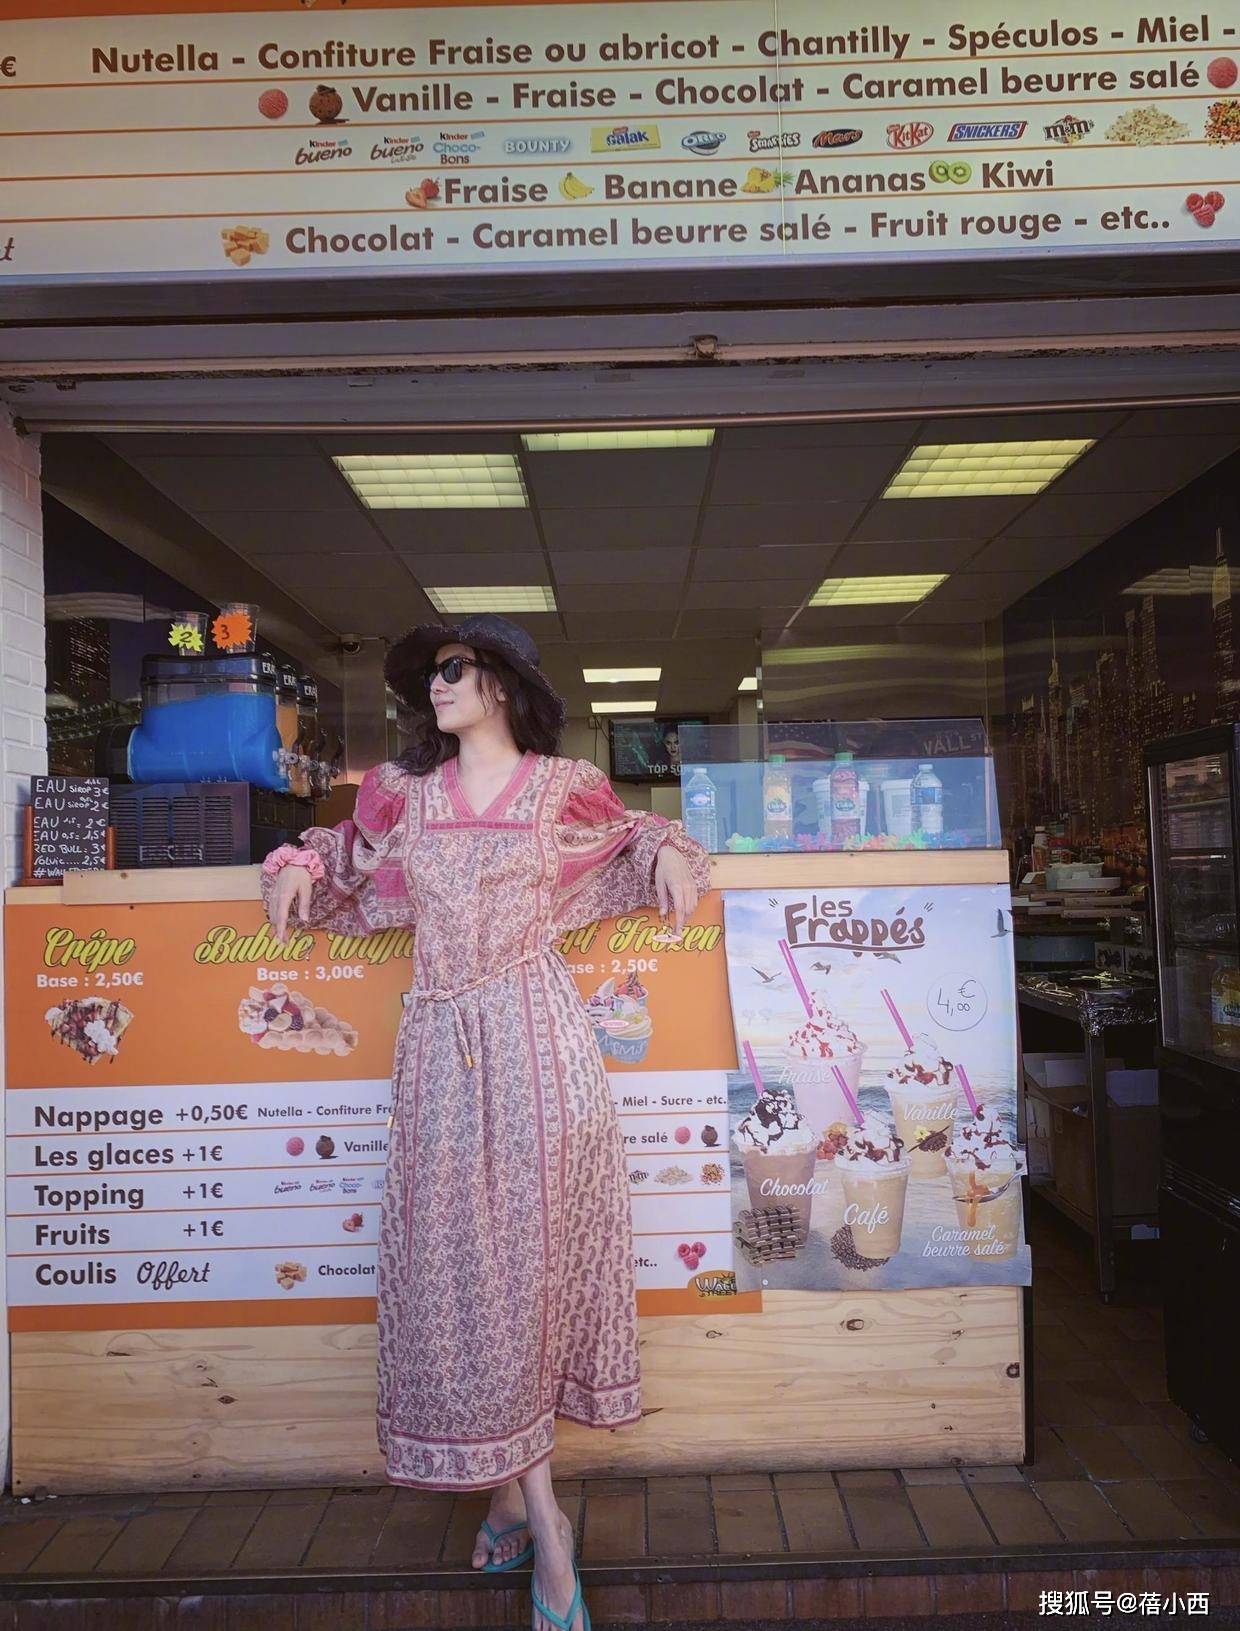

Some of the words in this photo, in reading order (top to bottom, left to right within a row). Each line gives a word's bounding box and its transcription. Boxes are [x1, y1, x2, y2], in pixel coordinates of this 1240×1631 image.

[93, 44, 218, 73] Nutella
[258, 41, 415, 69] Confiture
[430, 38, 532, 65] Fraise
[545, 43, 586, 62] ou
[599, 33, 719, 61] abricot
[758, 25, 910, 59] Chantilly
[948, 20, 1098, 56] Spéculos
[1137, 15, 1208, 43] Miel
[352, 83, 473, 112] Vanille
[513, 81, 616, 108] Fraise
[655, 76, 804, 105] Chocolat
[842, 67, 988, 99] Caramel
[1001, 67, 1117, 93] beurre
[1130, 61, 1199, 89] salé
[954, 124, 1020, 139] SNICKERS
[370, 144, 424, 160] bueno
[505, 139, 571, 154] BOUNTY
[295, 148, 352, 165] bueno
[441, 155, 469, 164] Bons
[444, 177, 548, 204] Fraise
[605, 174, 737, 199] Banane
[795, 169, 926, 193] Ananas
[983, 160, 1054, 188] Kiwi
[285, 225, 434, 253] Chocolat
[473, 218, 617, 248] Caramel
[632, 218, 747, 245] beurre
[760, 212, 830, 241] salé
[871, 210, 947, 237] Fruit
[961, 210, 1061, 240] rouge
[1101, 206, 1169, 229] etc..
[221, 625, 230, 640] 3
[648, 765, 668, 773] TOP
[36, 779, 66, 792] EAU
[35, 797, 65, 810] EAU
[34, 816, 59, 828] EAU
[813, 895, 852, 918] les
[44, 926, 135, 973] Crêpe
[257, 967, 298, 982] Base
[315, 966, 364, 981] 3,00€
[567, 963, 594, 974] ase
[611, 959, 658, 974] 2,50€
[37, 974, 78, 988] Base
[95, 973, 144, 988] 2,50€
[622, 1096, 647, 1106] Miel
[661, 1096, 693, 1105] Sucre
[34, 1105, 163, 1132] Nappage
[176, 1104, 248, 1124] +0,50€
[258, 1104, 302, 1118] Nutella
[316, 1103, 371, 1117] Confiture
[903, 1104, 959, 1122] Vanille
[641, 1132, 668, 1143] salé
[34, 1145, 78, 1167] Les
[88, 1142, 173, 1171] glaces
[182, 1145, 223, 1163] +1€
[760, 1178, 829, 1197] Chocolat
[34, 1183, 144, 1212] Topping
[183, 1183, 223, 1200] +1€
[844, 1203, 889, 1233] Café
[35, 1224, 111, 1246] Fruits
[183, 1221, 224, 1238] +1€
[931, 1224, 995, 1243] Caramel
[922, 1240, 971, 1257] beurre
[35, 1263, 117, 1286] Coulis
[137, 1261, 210, 1290] Offert
[318, 1264, 375, 1277] Chocolat
